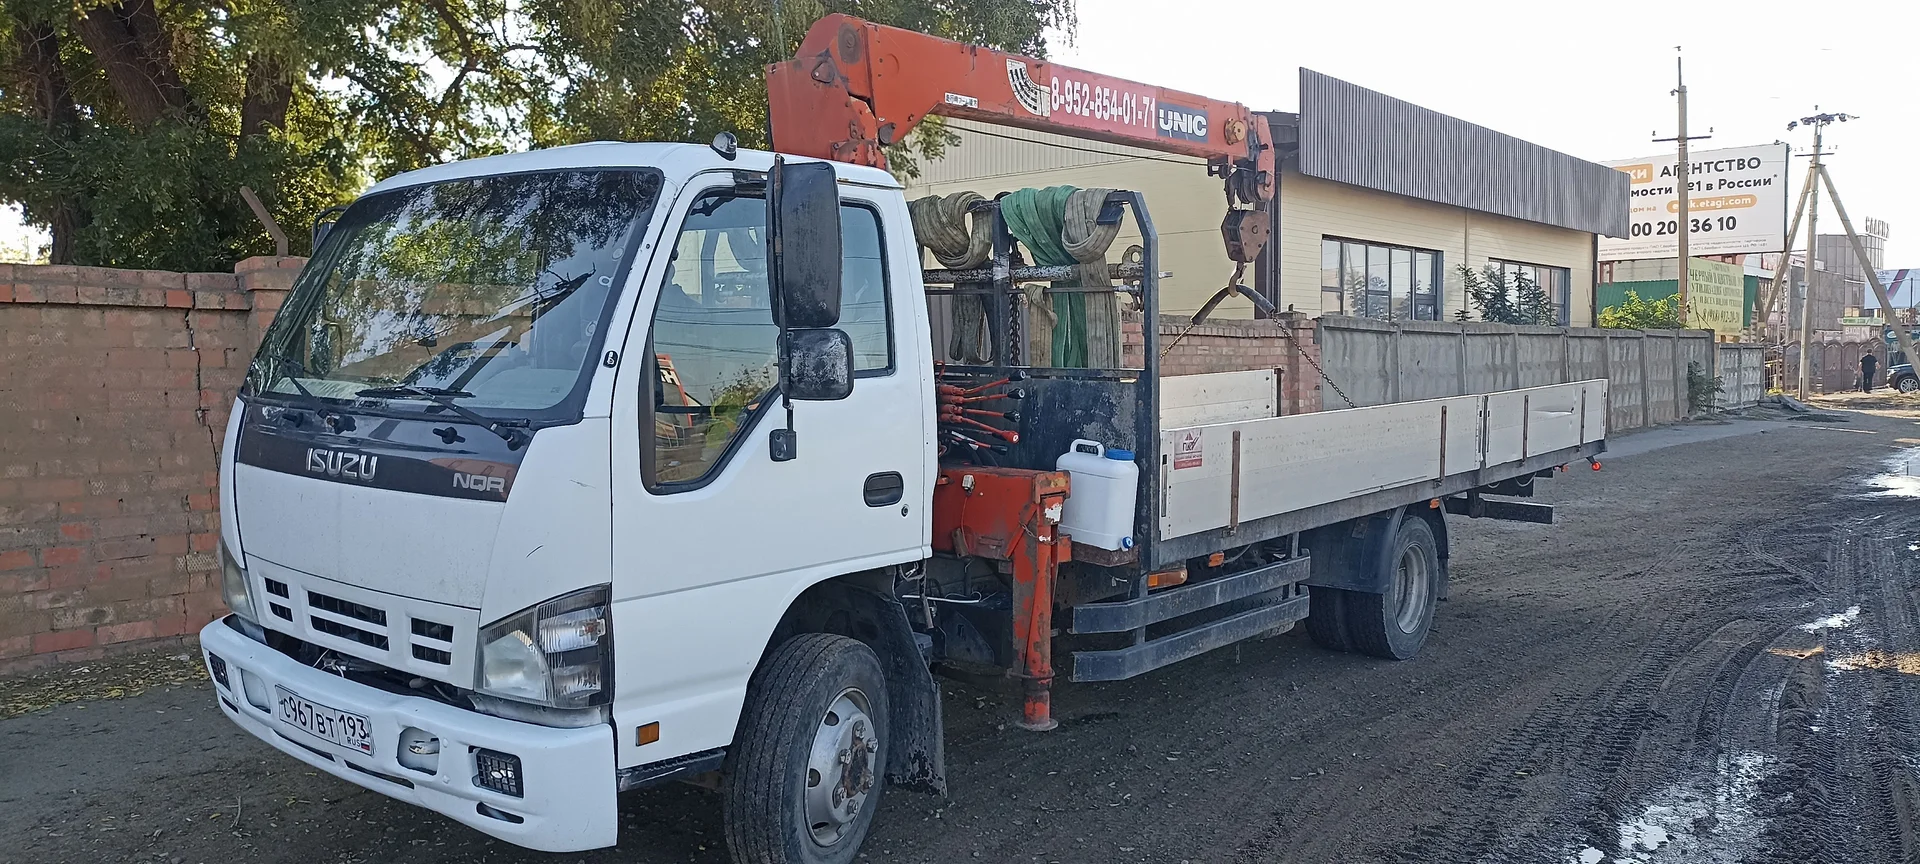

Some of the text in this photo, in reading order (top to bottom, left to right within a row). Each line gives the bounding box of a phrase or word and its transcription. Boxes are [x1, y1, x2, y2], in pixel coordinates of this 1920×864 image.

[1051, 76, 1156, 129] 8-952-854-01-71
[1159, 109, 1207, 137] UNIC
[1660, 156, 1762, 178] АГНТСТВО
[1690, 217, 1713, 234] 36
[1717, 215, 1737, 231] 10
[306, 447, 378, 481] ISUZU
[452, 472, 506, 493] NQR
[338, 714, 367, 740] 193
[346, 737, 361, 748] RUS
